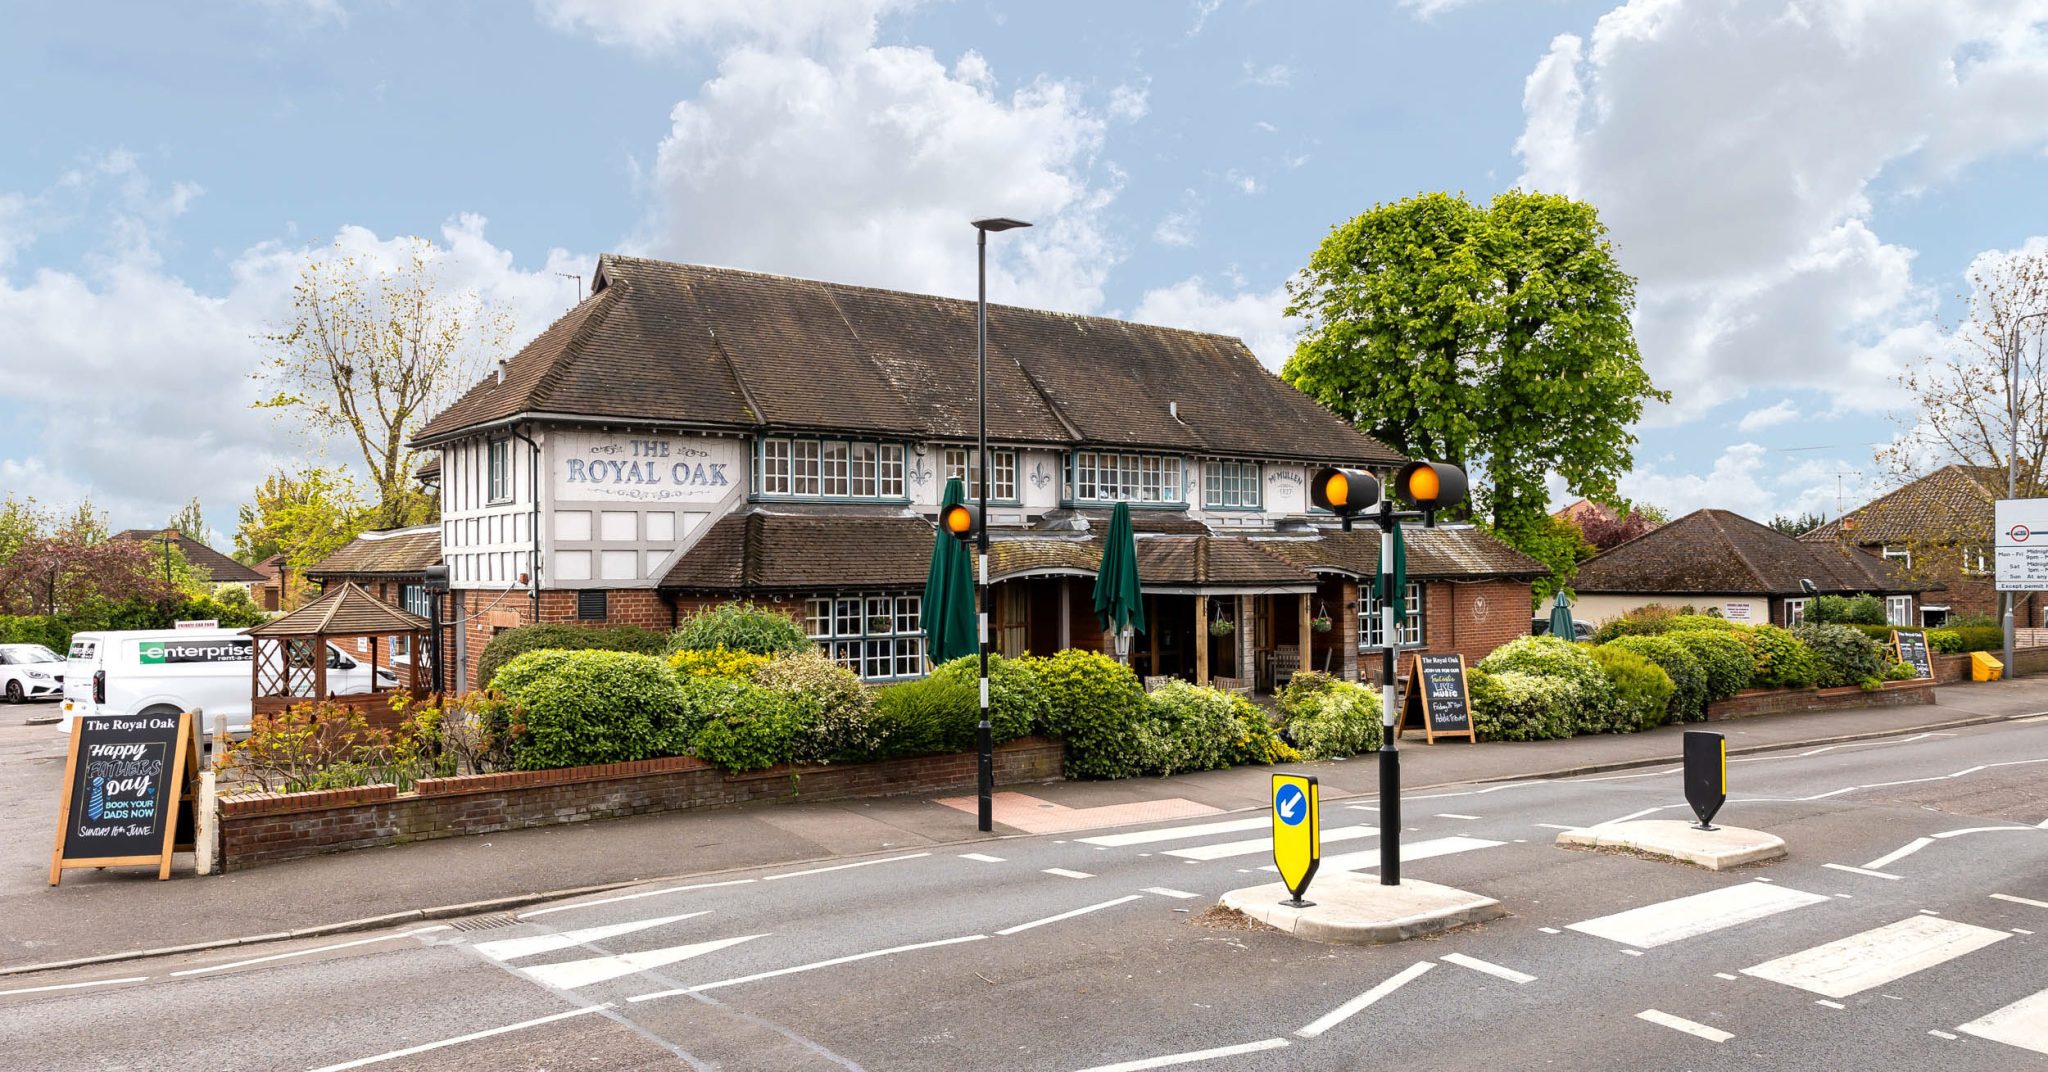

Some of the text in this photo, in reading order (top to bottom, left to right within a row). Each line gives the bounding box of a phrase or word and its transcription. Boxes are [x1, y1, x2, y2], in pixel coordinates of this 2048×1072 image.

[629, 439, 671, 458] THE
[566, 458, 729, 486] ROYAL OAK
[146, 644, 253, 659] enterprise
[87, 718, 175, 732] The Royal Oak
[90, 744, 148, 761] Happy
[106, 775, 152, 797] Day
[106, 800, 154, 809] BOOK YOUR
[103, 809, 154, 820] DADS NOW
[126, 824, 152, 837] JUNE
